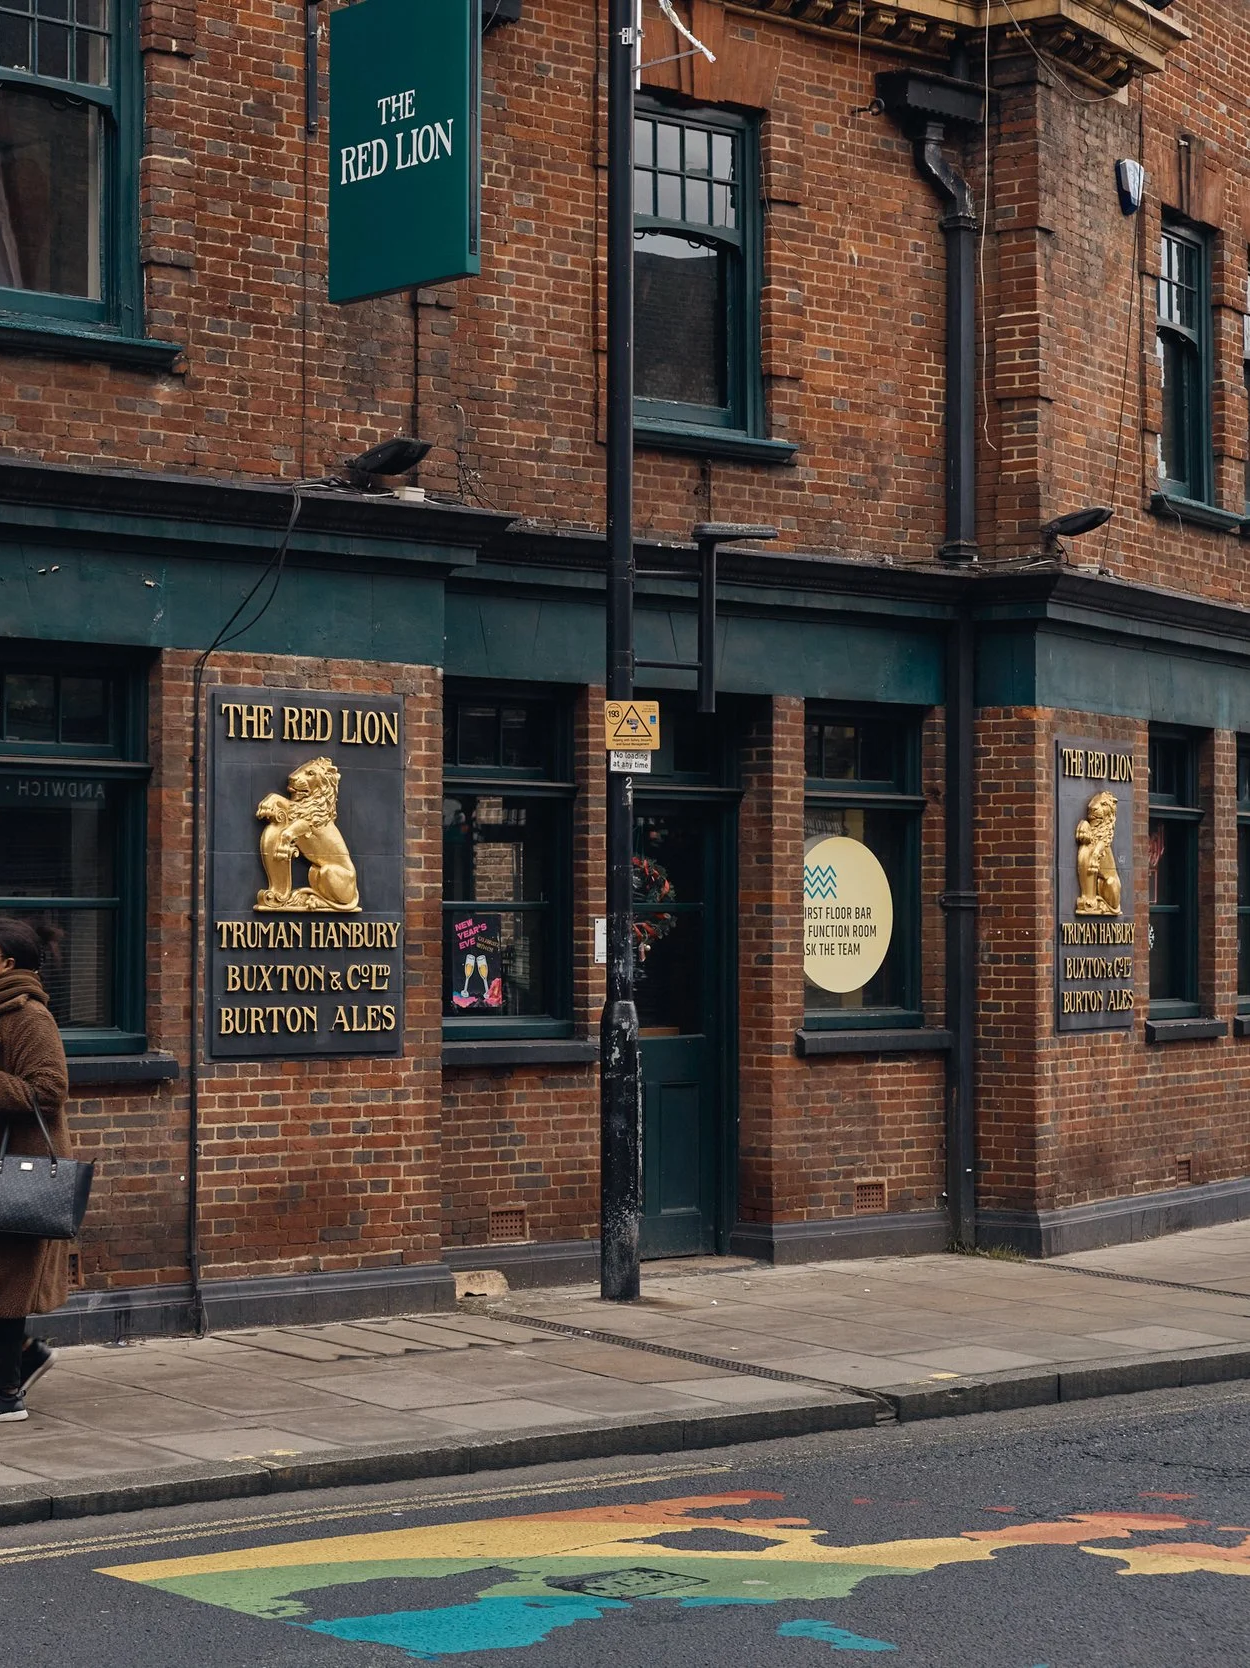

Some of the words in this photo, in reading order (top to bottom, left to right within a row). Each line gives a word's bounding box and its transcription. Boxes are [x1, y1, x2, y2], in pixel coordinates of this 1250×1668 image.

[377, 89, 416, 126] THE
[340, 138, 388, 185] RED
[395, 118, 454, 170] LION
[221, 702, 274, 740] THE
[282, 706, 333, 742] RED
[341, 709, 399, 745] LION
[608, 710, 620, 718] 193
[613, 751, 623, 759] No
[625, 751, 648, 760] loading
[634, 761, 649, 769] time
[1062, 748, 1085, 777] THE
[1087, 750, 1108, 779] RED
[1110, 753, 1134, 782] LION
[625, 776, 633, 789] 2
[804, 906, 824, 920] IRST
[825, 906, 852, 920] FLOOR
[854, 906, 872, 920] BAR
[454, 918, 473, 932] NEW
[457, 923, 487, 940] YEAR'S
[808, 924, 850, 938] FUNCTION
[852, 924, 877, 938] ROOM
[1062, 922, 1097, 945] TRUMAN
[1099, 922, 1136, 944] HANBURY
[216, 920, 304, 950] TRUMAN
[310, 921, 401, 949] HANBURY
[458, 937, 476, 950] EVE
[819, 943, 835, 956] THE
[838, 943, 861, 956] TEAM
[1066, 957, 1107, 979] BUXTON
[226, 964, 325, 993] BUXTON
[329, 971, 344, 992] &
[1063, 989, 1104, 1013] BURTON
[1107, 988, 1134, 1011] ALES
[220, 1005, 318, 1036] BURTON
[332, 1004, 396, 1033] ALES
